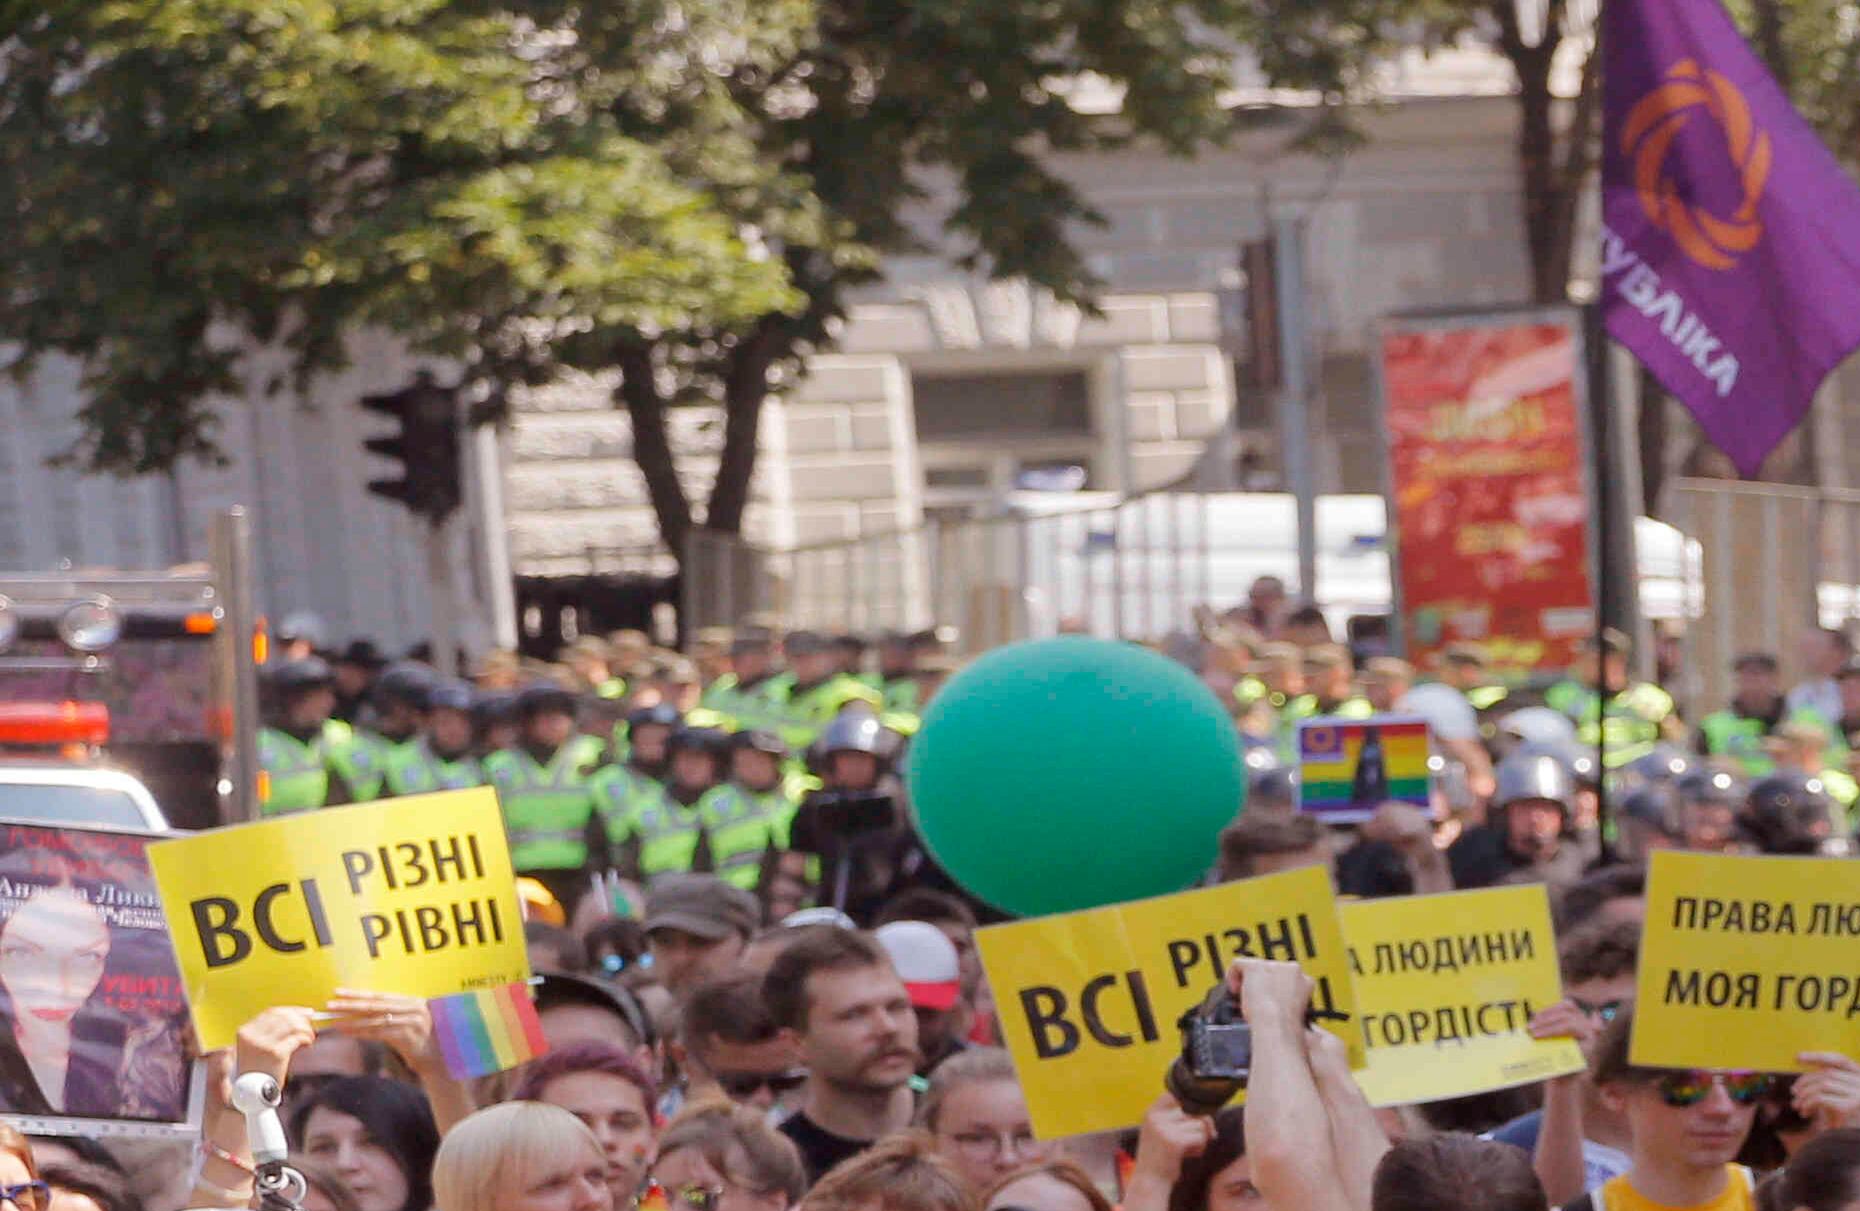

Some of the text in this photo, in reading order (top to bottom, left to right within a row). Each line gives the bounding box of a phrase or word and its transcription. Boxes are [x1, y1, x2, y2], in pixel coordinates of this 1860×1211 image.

[1600, 224, 1740, 397] УБЛІКА
[341, 834, 485, 895] РІЗНІ
[190, 878, 334, 968] ВСІ
[360, 898, 503, 958] РІВНІ
[1673, 897, 1795, 934] ПРАВА
[1374, 929, 1534, 975] ЛЮДИНИ
[1019, 969, 1160, 1058] ВСІ
[1664, 969, 1760, 1008] МОЯ
